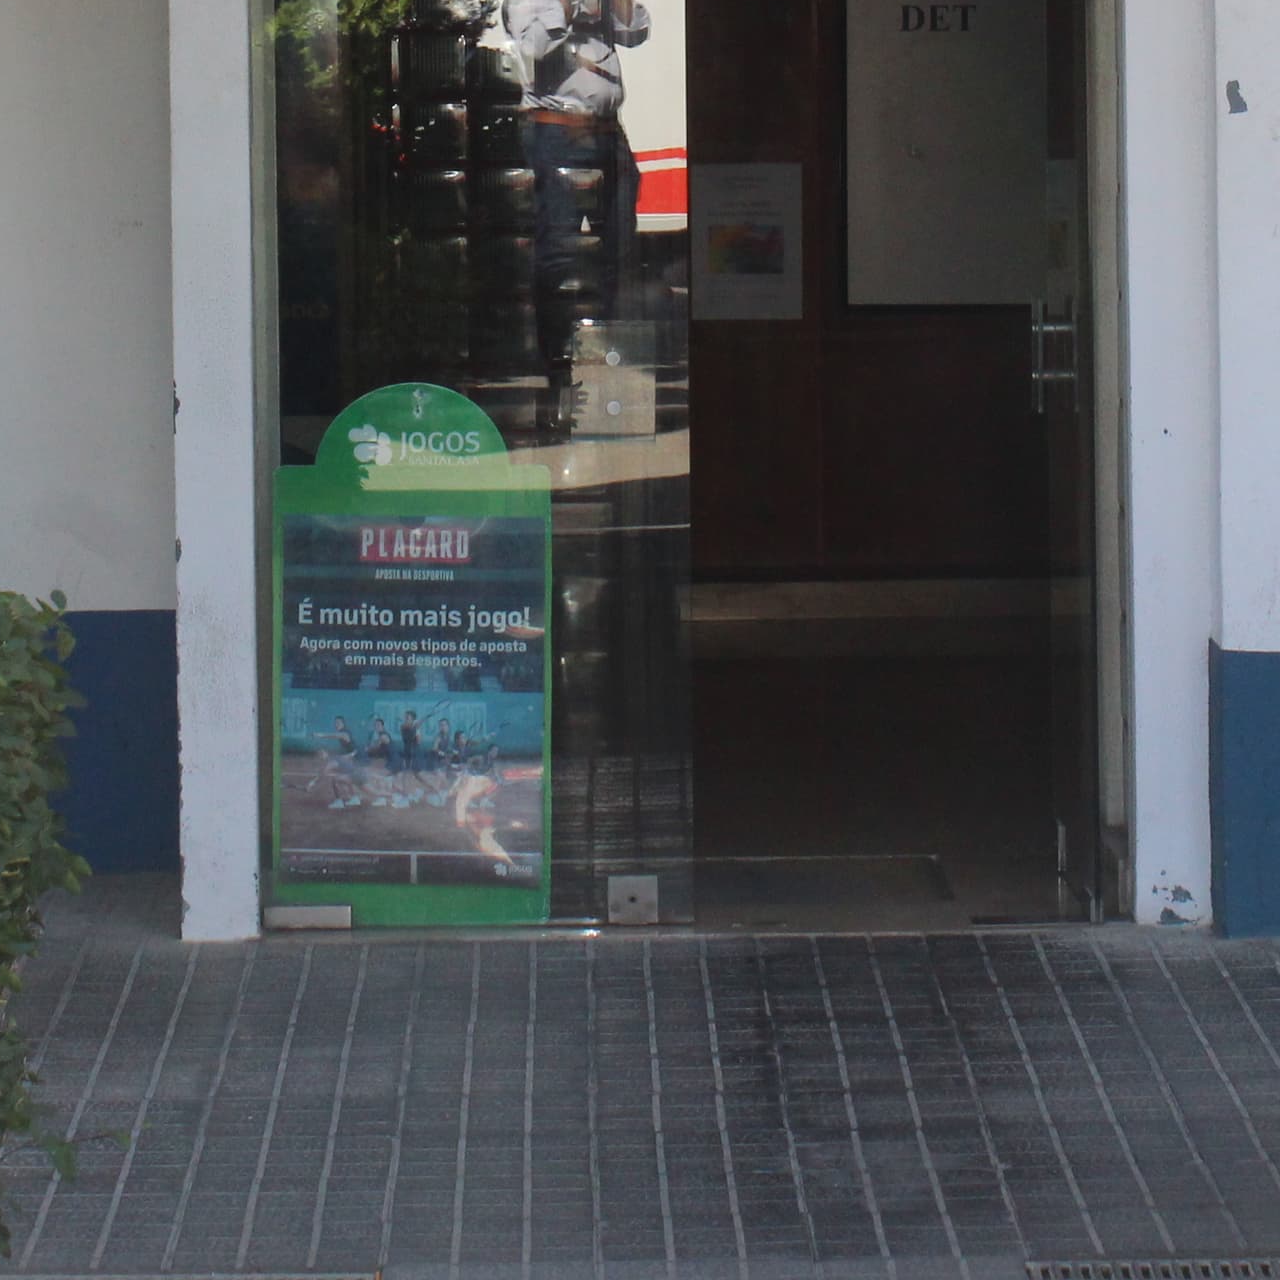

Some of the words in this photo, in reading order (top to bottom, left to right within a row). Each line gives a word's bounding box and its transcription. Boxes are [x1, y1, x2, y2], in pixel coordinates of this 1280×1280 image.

[900, 4, 977, 33] DET
[400, 431, 480, 460] JOGOS
[360, 528, 470, 559] PLACARD
[298, 598, 313, 625] É
[320, 602, 394, 627] muito
[400, 604, 462, 627] mais
[467, 606, 531, 634] jogo!
[300, 636, 340, 653] Agora
[343, 640, 373, 650] com
[376, 640, 418, 651] novos
[421, 637, 457, 655] tipos
[459, 638, 476, 651] de
[479, 639, 527, 656] aposta
[344, 655, 366, 666] em
[370, 654, 404, 667] mais
[407, 654, 483, 669] desportos.
